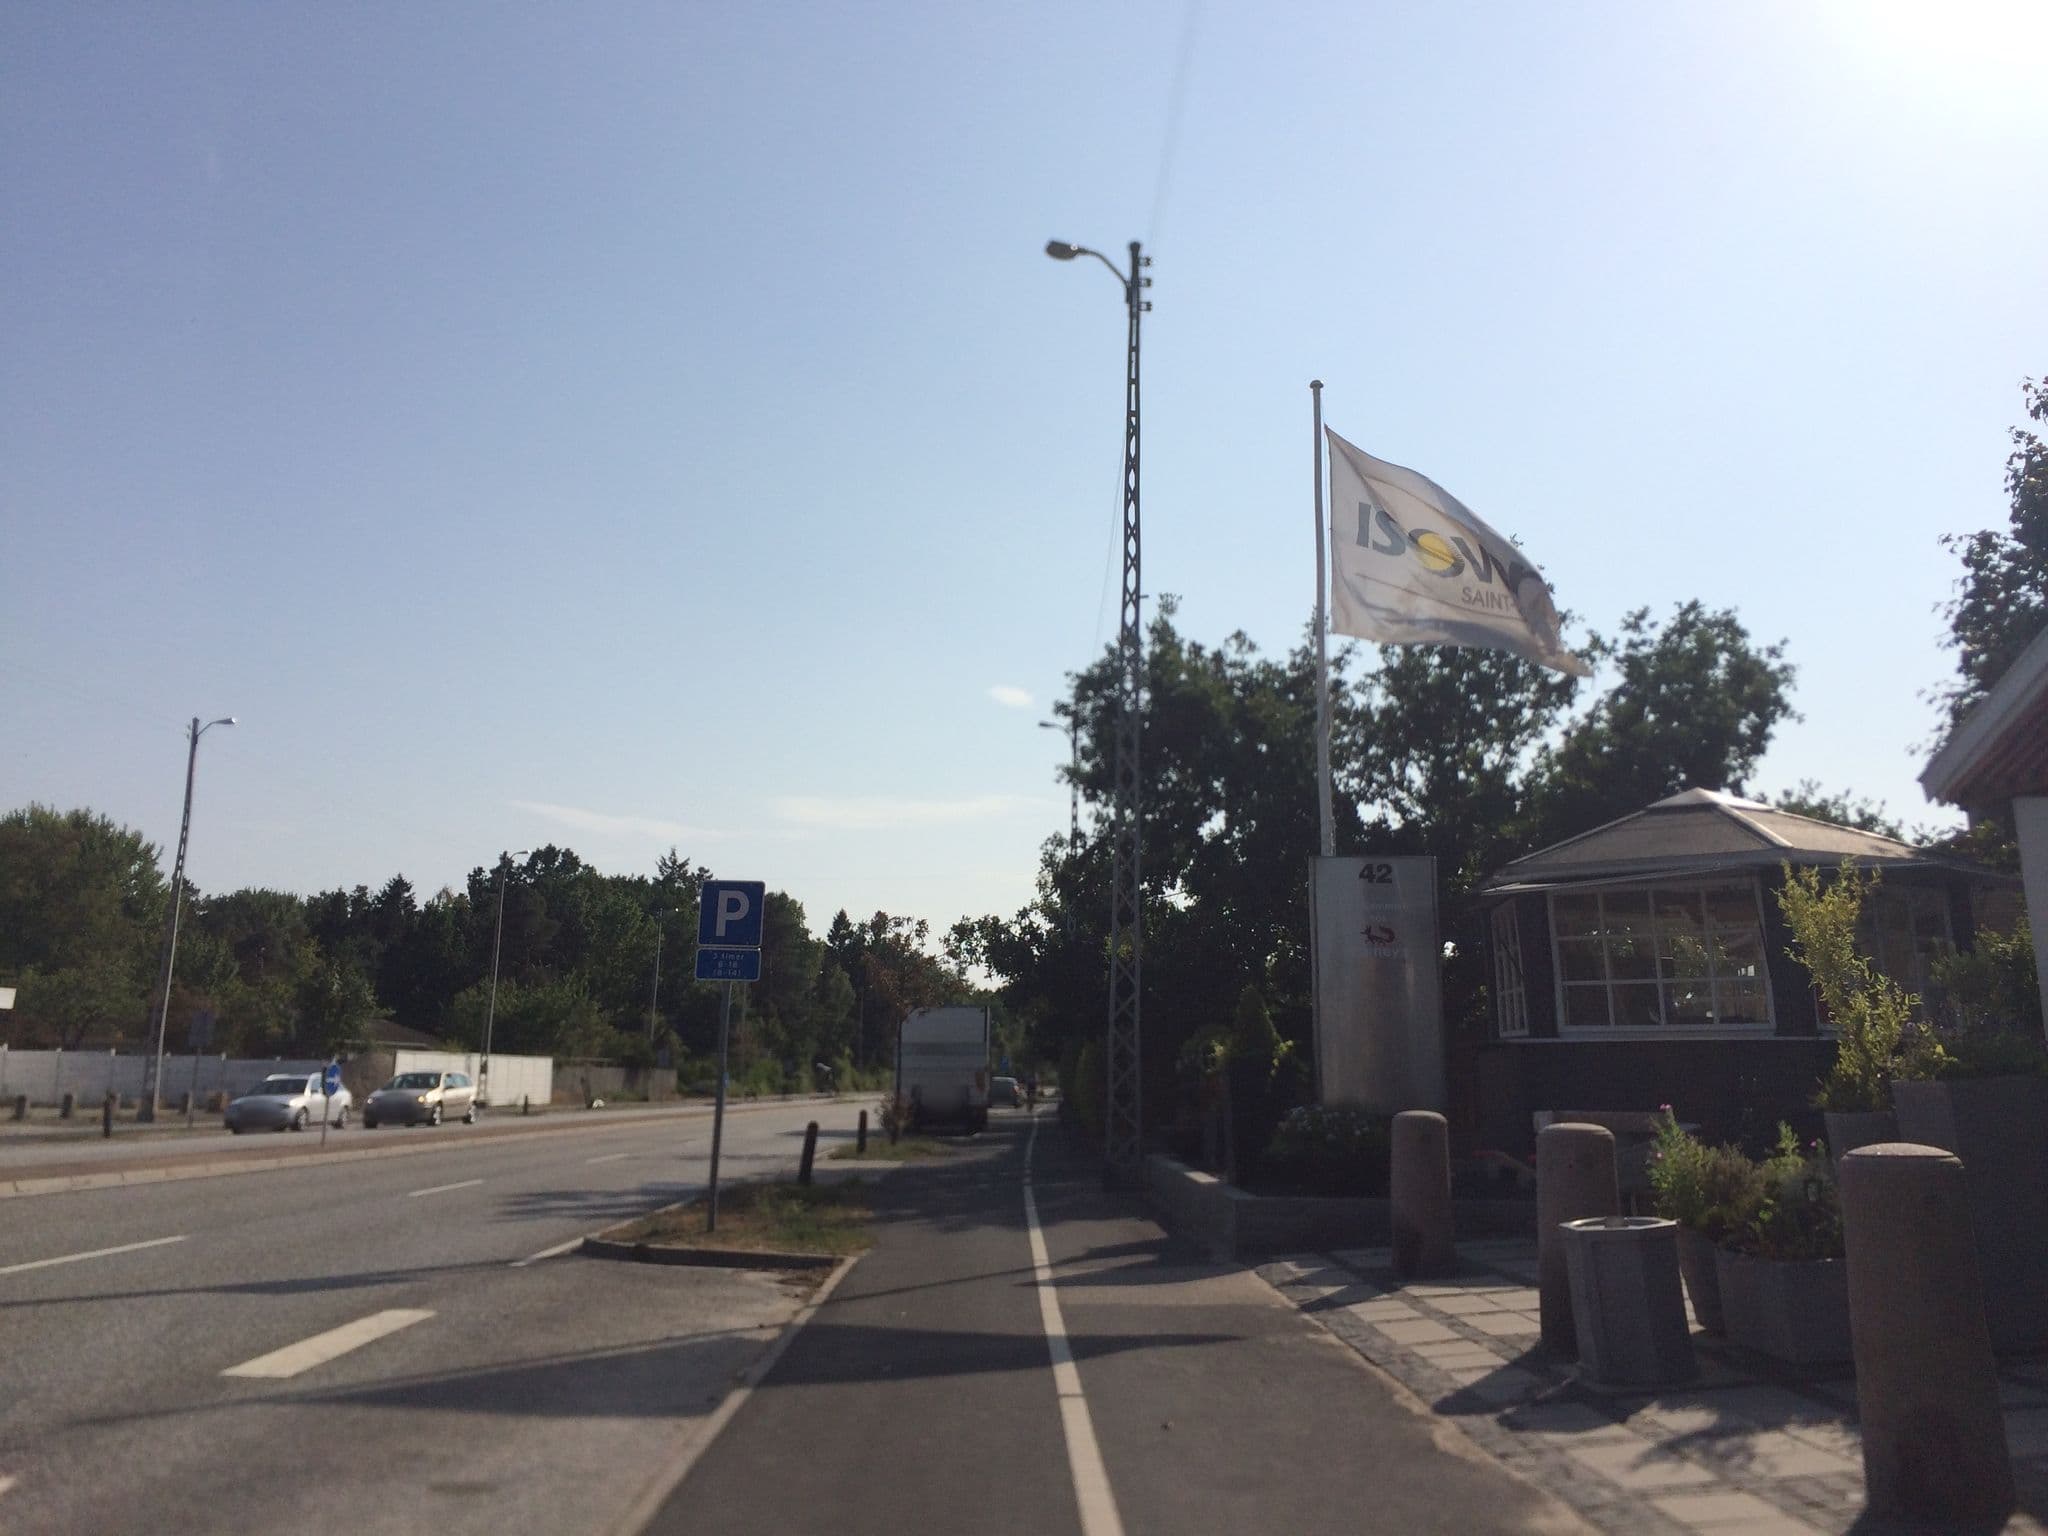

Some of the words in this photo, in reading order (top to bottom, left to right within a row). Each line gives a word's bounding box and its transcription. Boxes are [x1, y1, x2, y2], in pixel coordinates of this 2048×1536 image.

[1356, 501, 1530, 595] ISOV
[1359, 863, 1393, 884] 42
[715, 889, 750, 937] P
